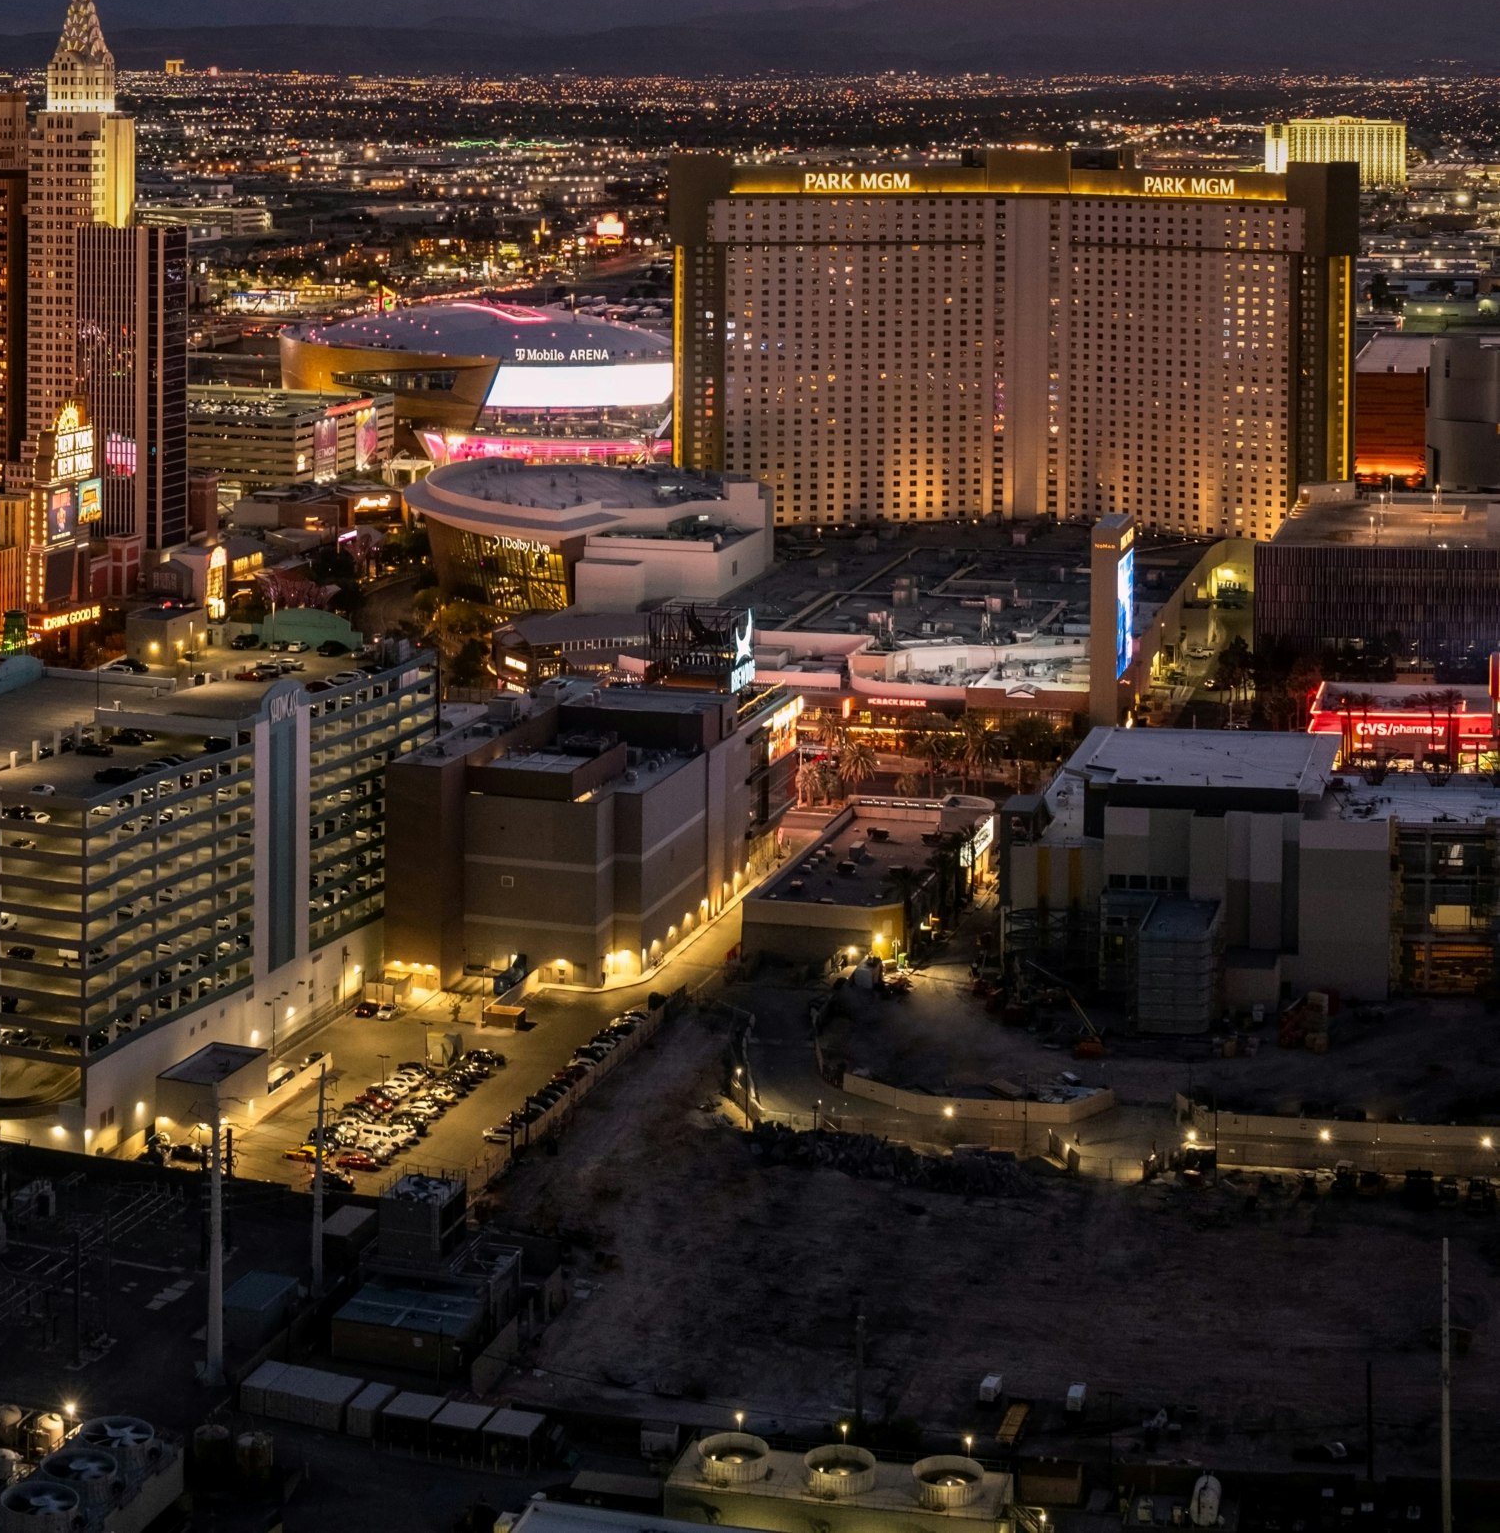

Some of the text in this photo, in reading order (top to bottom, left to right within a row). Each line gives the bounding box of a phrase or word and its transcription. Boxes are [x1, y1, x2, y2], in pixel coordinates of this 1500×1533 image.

[804, 173, 910, 190] PARK MGM
[1144, 176, 1235, 195] PARK MGM
[569, 349, 609, 360] ARENA
[58, 430, 94, 454] NEW YORK
[58, 452, 93, 477] NEW YORK
[505, 537, 550, 554] Dolby Live
[69, 610, 91, 624] GOOD
